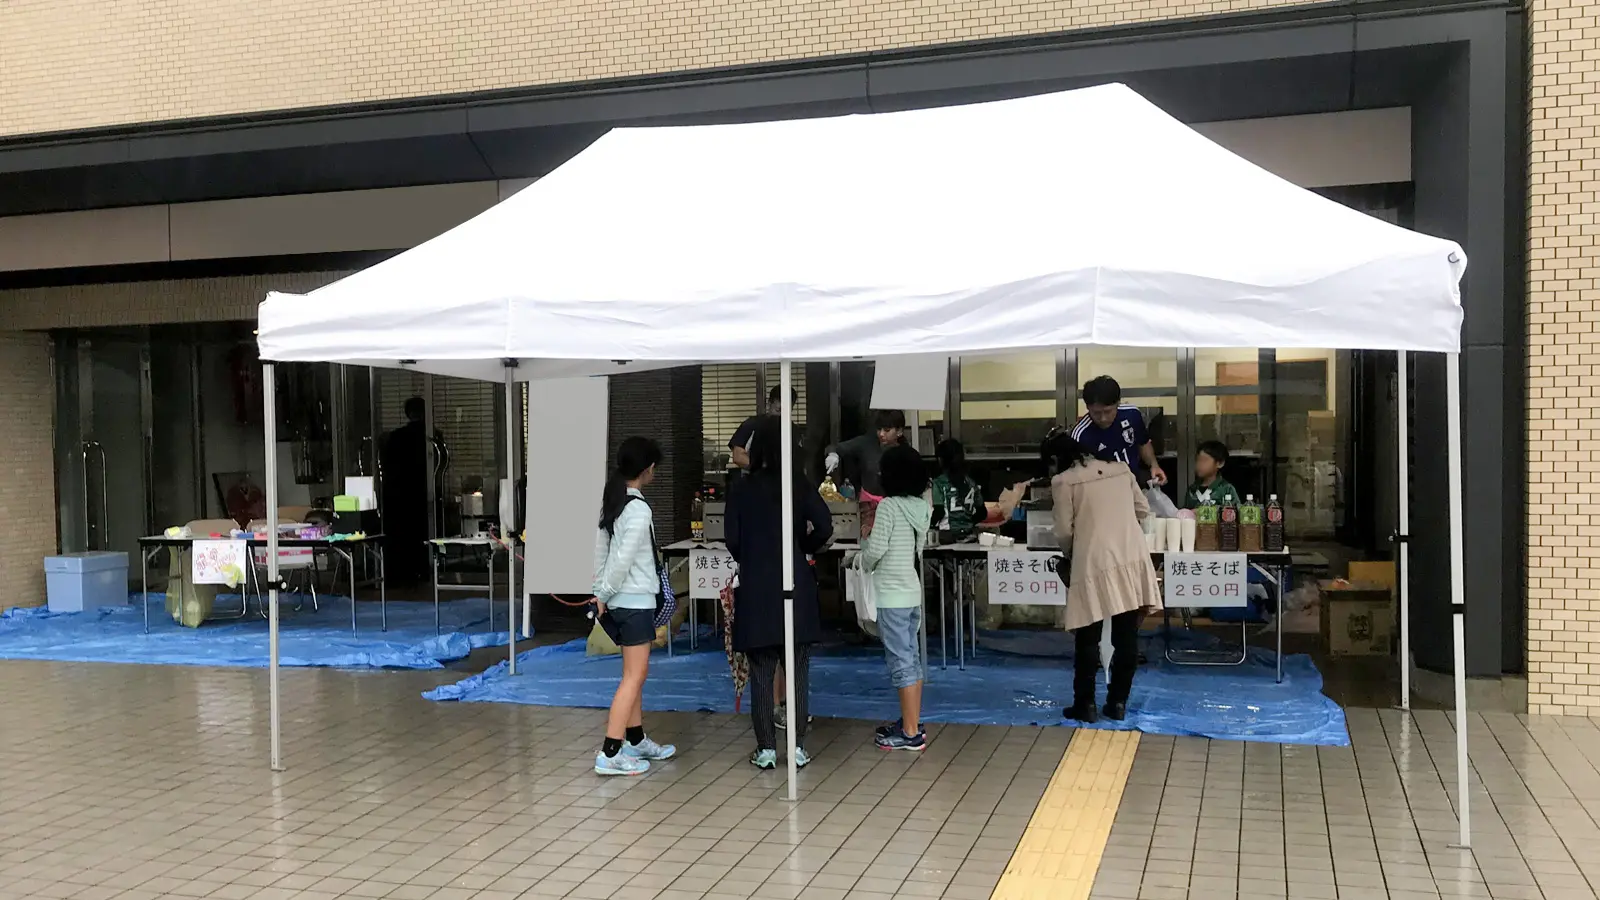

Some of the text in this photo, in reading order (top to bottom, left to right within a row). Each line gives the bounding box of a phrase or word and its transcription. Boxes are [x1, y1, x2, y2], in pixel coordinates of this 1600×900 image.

[1113, 447, 1130, 465] 11
[695, 555, 735, 570] 焼きそ
[1171, 560, 1240, 576] 焼きそば
[697, 577, 732, 589] 250
[998, 580, 1058, 595] 250円
[1175, 583, 1239, 597] 250円
